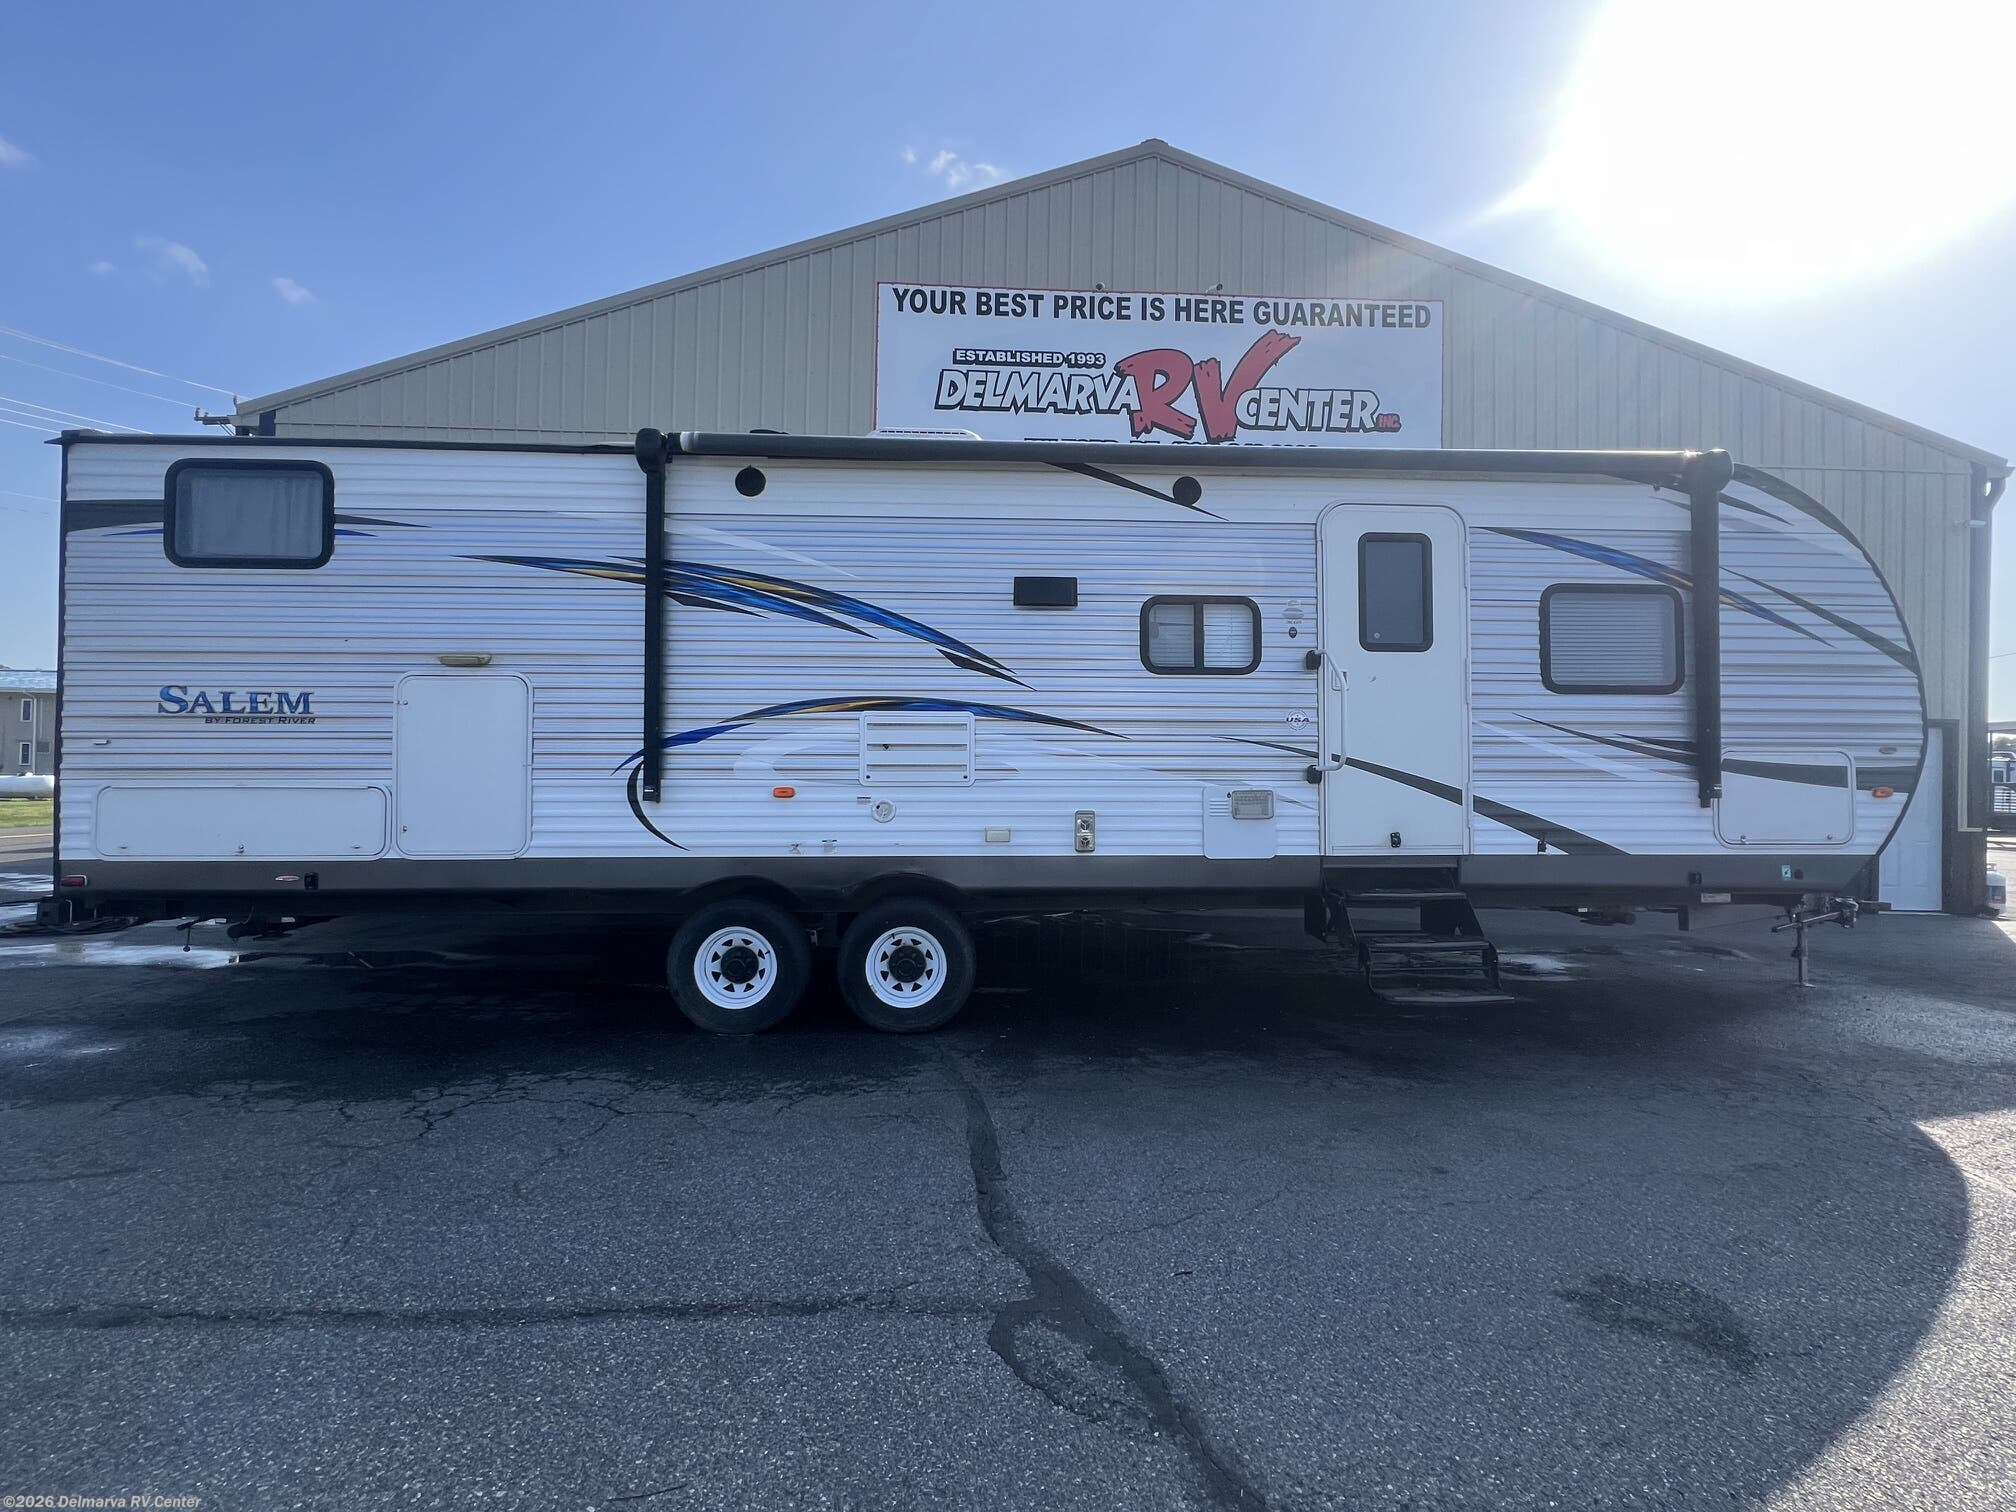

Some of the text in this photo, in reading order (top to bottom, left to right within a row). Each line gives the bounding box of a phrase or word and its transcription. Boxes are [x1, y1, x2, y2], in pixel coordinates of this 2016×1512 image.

[892, 288, 1431, 328] YOUR BEST PRICE IS HERE GUARANTEED
[954, 349, 1106, 369] ESTABLISHED 1993
[935, 369, 1142, 415] DELMARVA
[1114, 329, 1302, 443] RV
[1235, 388, 1380, 432] CENTER
[158, 685, 314, 714] SALEM
